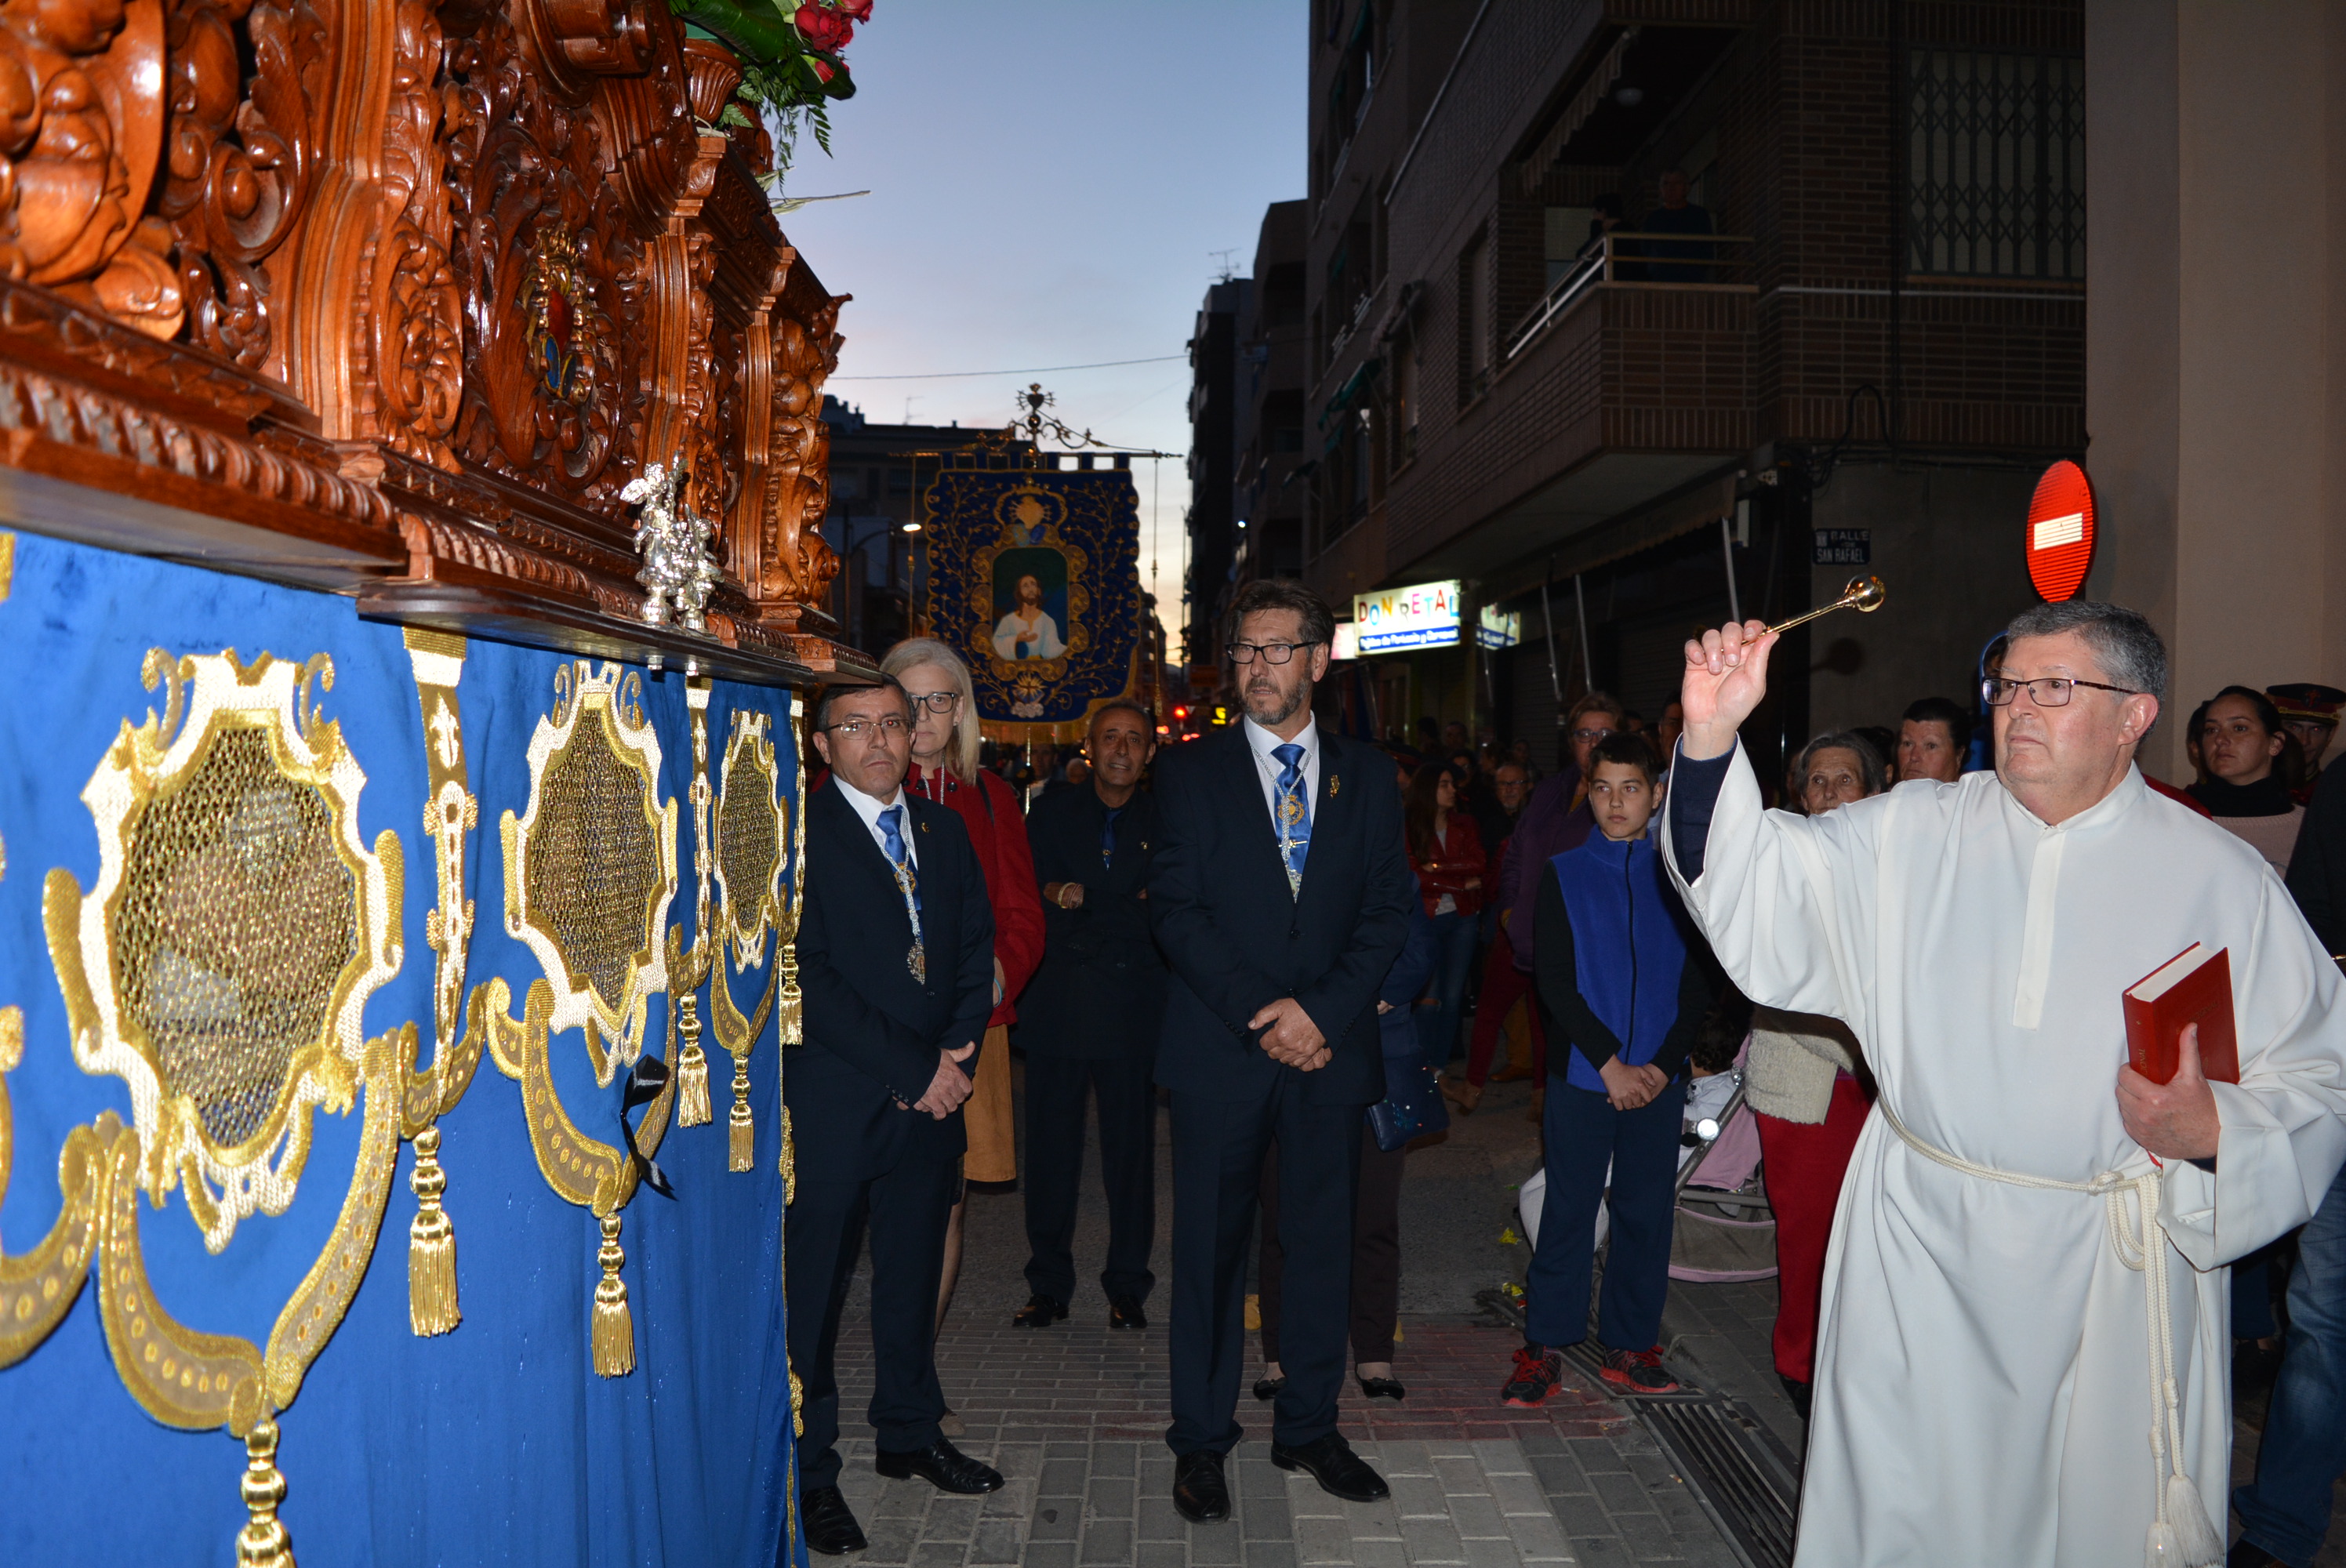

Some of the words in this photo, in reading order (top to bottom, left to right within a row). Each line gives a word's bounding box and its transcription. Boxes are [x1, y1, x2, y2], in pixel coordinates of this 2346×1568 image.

[1817, 548, 1832, 562] SAN
[1835, 548, 1865, 563] RAFAEL
[1359, 596, 1393, 626] DON
